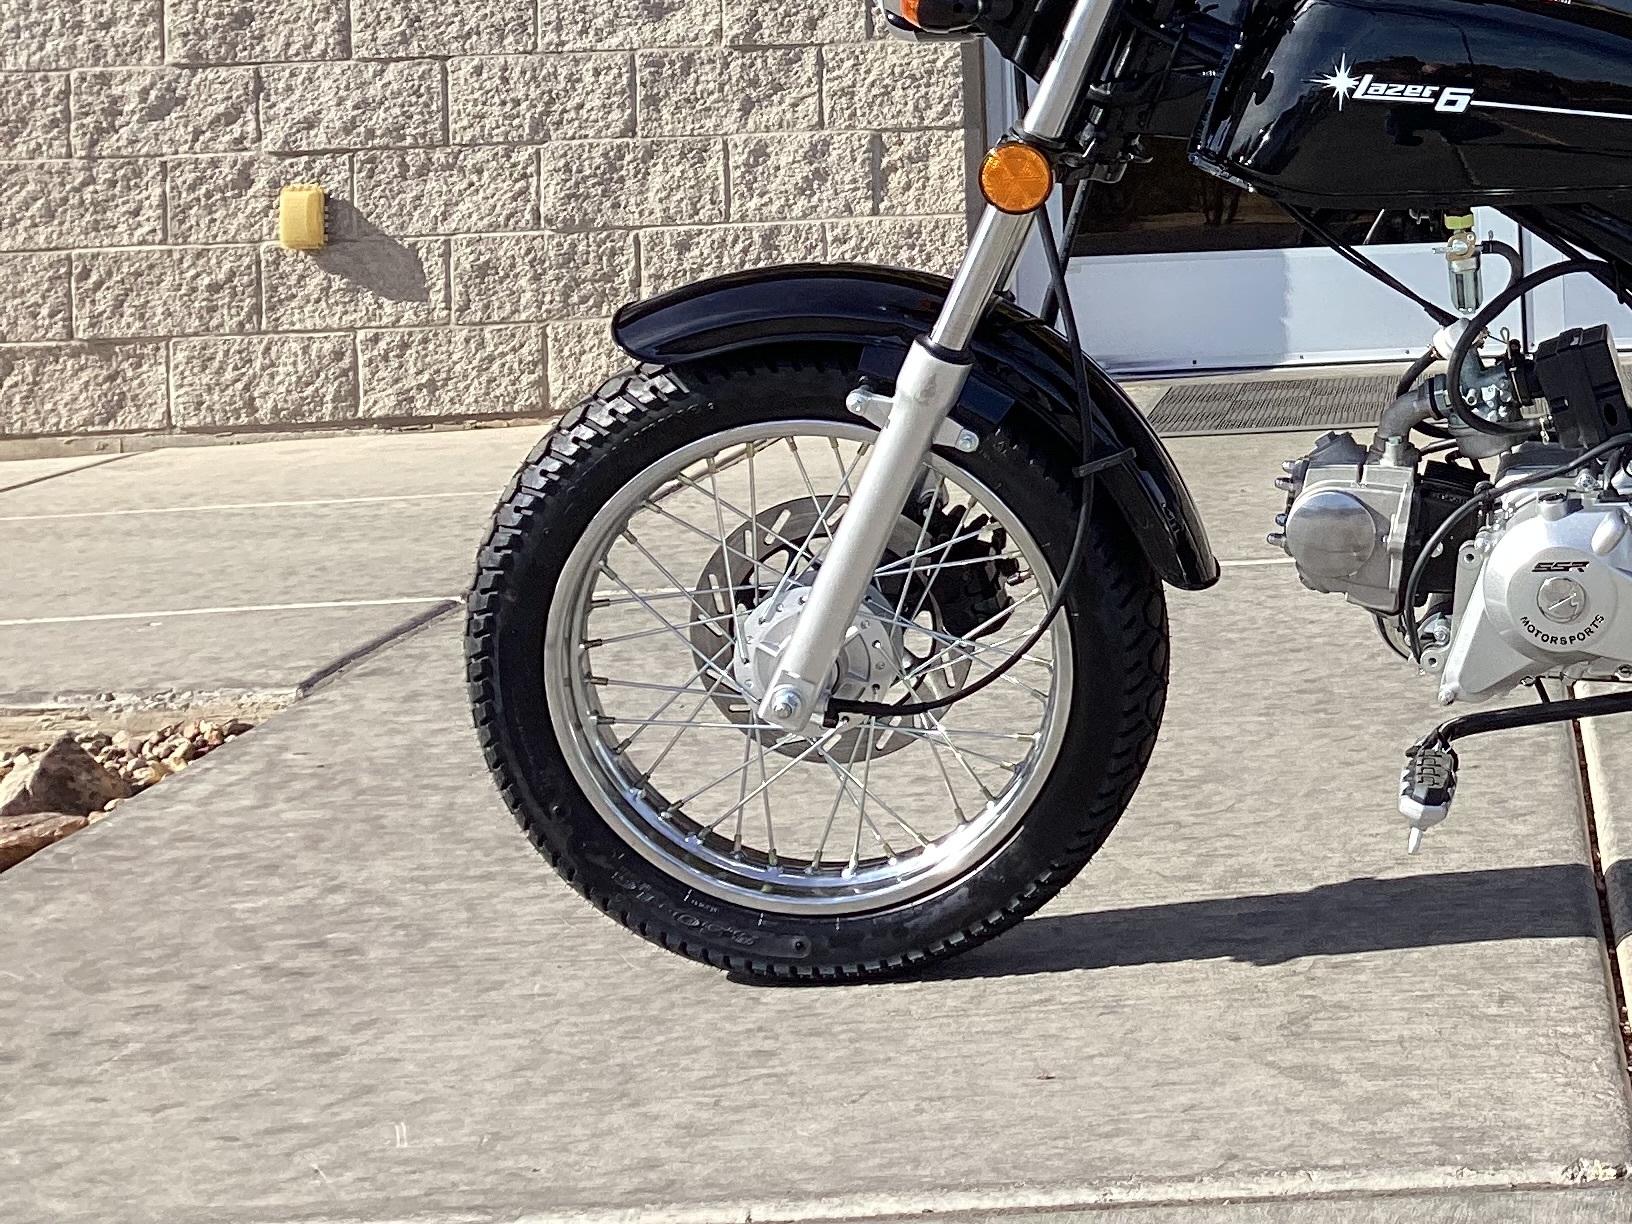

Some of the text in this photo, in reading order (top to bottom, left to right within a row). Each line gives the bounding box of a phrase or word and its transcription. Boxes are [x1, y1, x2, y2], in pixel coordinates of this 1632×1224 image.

[1434, 87, 1475, 113] 6
[1531, 561, 1590, 573] SSR
[1520, 613, 1605, 646] MOTORSPORTS
